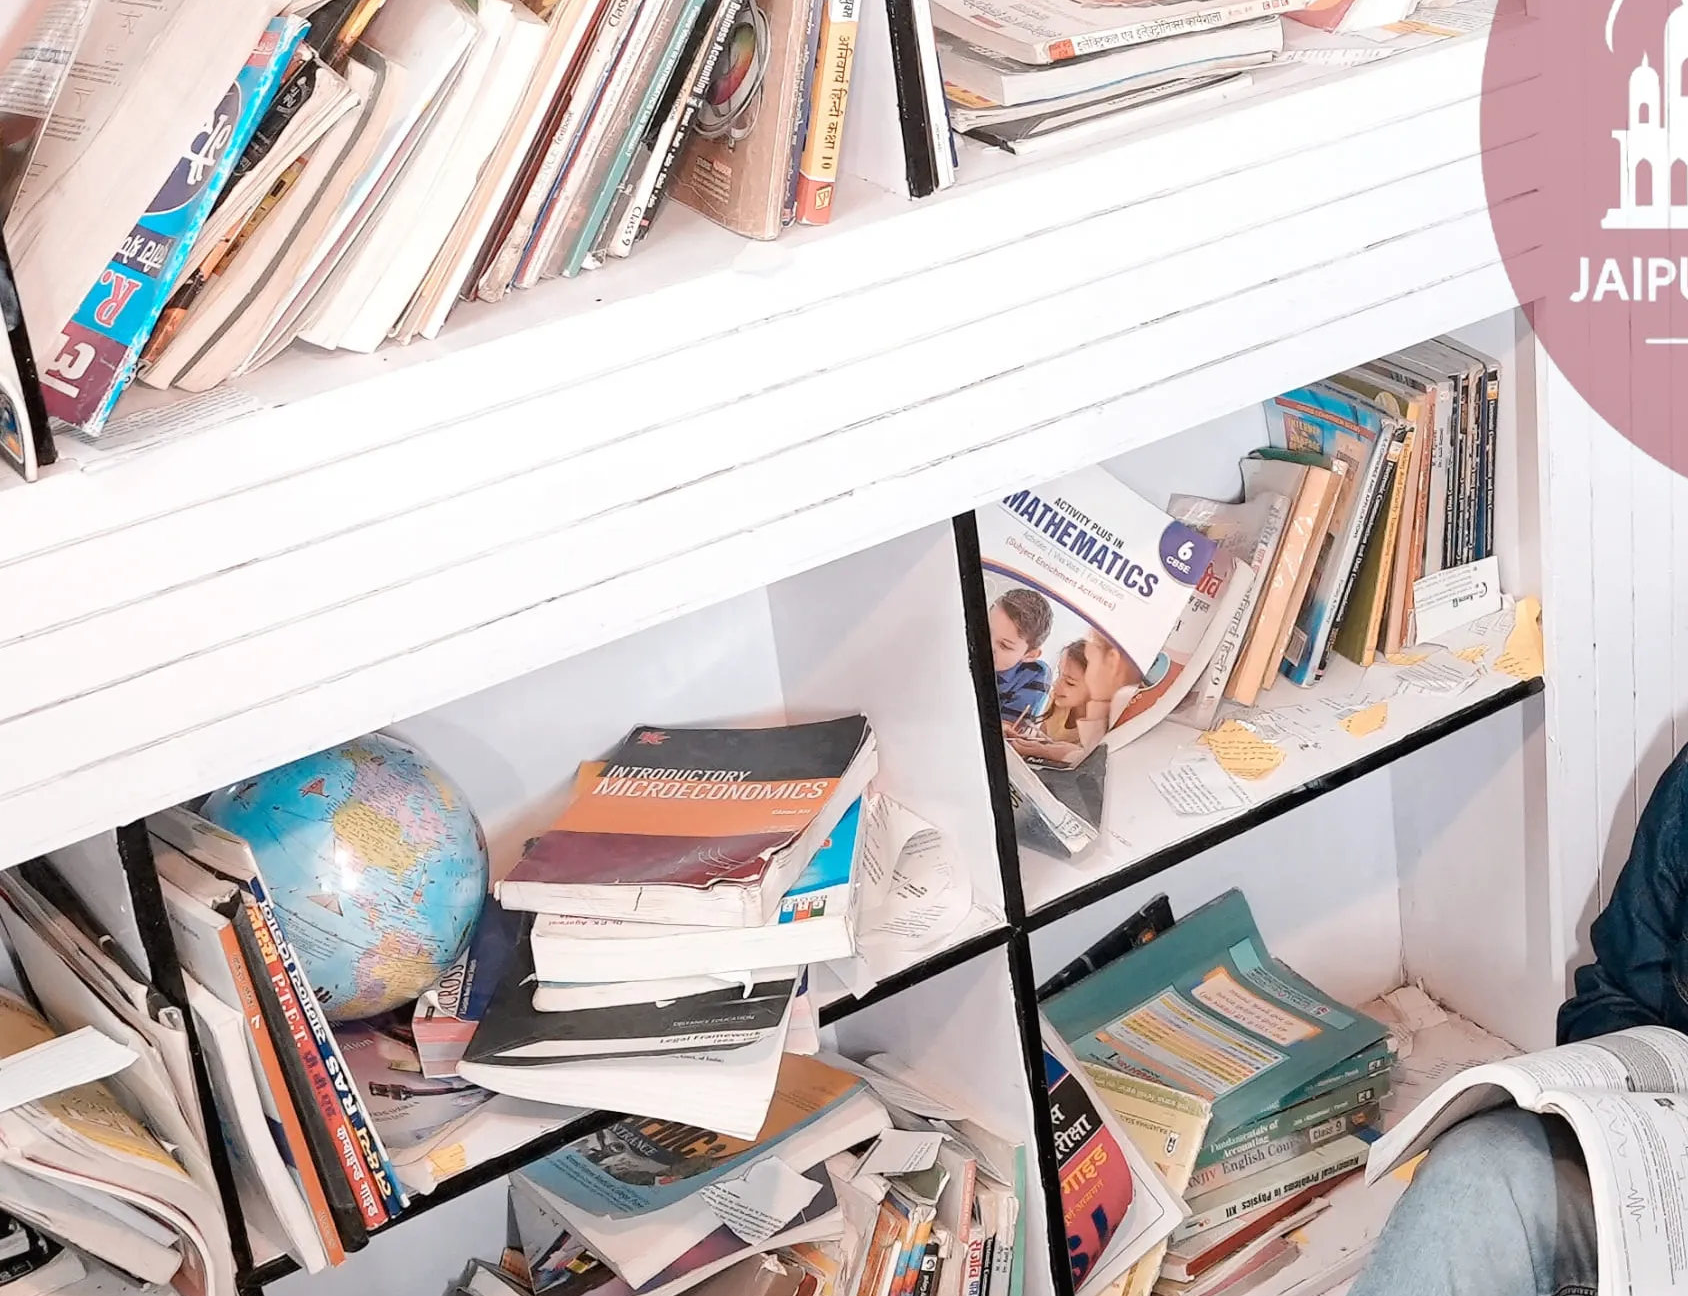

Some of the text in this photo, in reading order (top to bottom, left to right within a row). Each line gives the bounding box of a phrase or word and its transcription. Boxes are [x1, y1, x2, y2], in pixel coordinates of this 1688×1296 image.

[692, 1, 740, 95] Business Accounting
[832, 35, 853, 85] अनिवार्य
[827, 88, 846, 119] हिन्दी
[823, 122, 840, 150] कक्षा
[1051, 496, 1114, 542] ACTIVITY PLUS
[998, 484, 1163, 600] MATHEMATICS
[1176, 538, 1194, 562] 6
[1034, 555, 1079, 588] Enrichment
[1163, 554, 1192, 574] CBSE
[593, 776, 826, 801] MICROECONOMICS
[604, 763, 751, 785] INTRODUCTORY
[243, 902, 379, 1218] लक्ष्य P.T.E.T. गाइड
[256, 896, 396, 1199] लक्ष्य RAS सामान्य विज्ञान
[1209, 1123, 1272, 1153] Fundamentals
[1053, 1141, 1115, 1199] गाइड
[1219, 1145, 1268, 1177] English
[1239, 1170, 1320, 1211] Problems Physics
